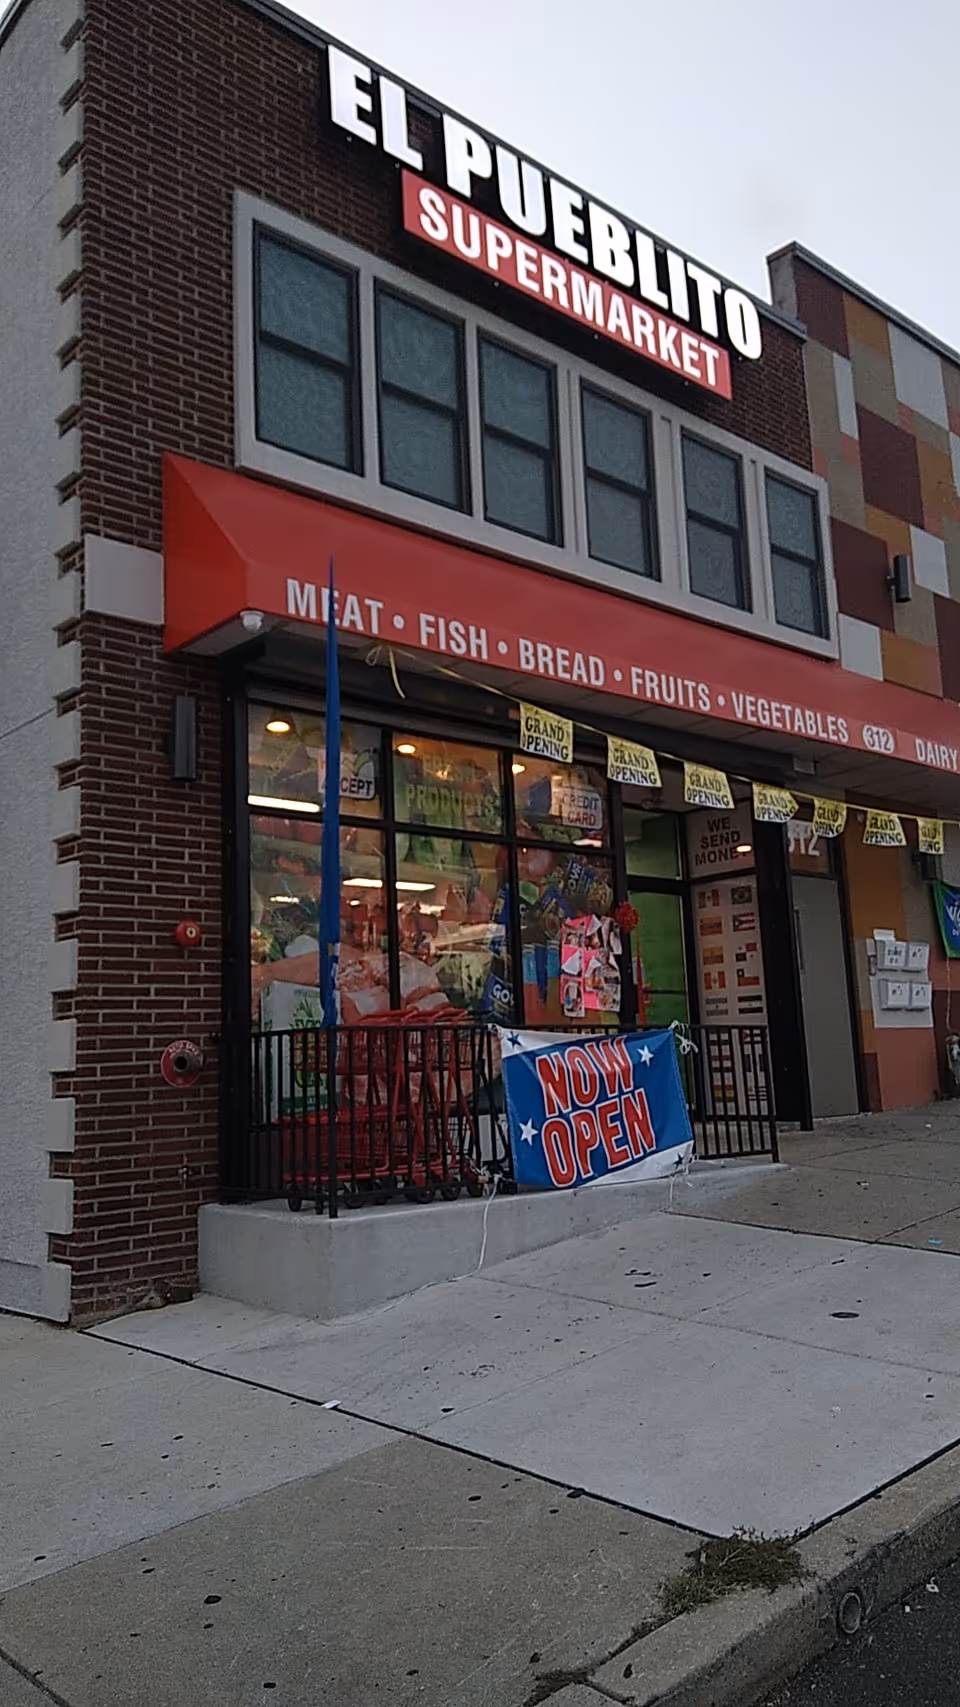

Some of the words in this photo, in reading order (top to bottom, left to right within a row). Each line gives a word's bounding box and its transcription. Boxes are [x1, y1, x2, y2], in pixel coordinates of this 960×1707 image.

[328, 44, 424, 171] EL
[442, 113, 762, 361] PUEBLITO
[418, 186, 720, 387] SUPERMARKET
[287, 578, 384, 635] MEAT
[419, 612, 488, 660] FISH
[518, 637, 606, 687] BREAD
[631, 666, 711, 712] FRUITS
[732, 692, 849, 744] VEGETABLES
[525, 716, 565, 743] GRAND
[866, 727, 892, 752] 312
[613, 748, 649, 770] GRAND
[915, 738, 958, 771] DAIRY
[610, 764, 658, 785] OPENING
[689, 772, 722, 793] GRAND
[563, 793, 600, 811] CREDIT
[686, 787, 730, 807] OPENING
[567, 811, 597, 827] CARD
[707, 816, 731, 833] WE
[700, 831, 741, 849] SEND
[535, 1035, 634, 1118] NOW
[542, 1087, 656, 1188] OPEN
